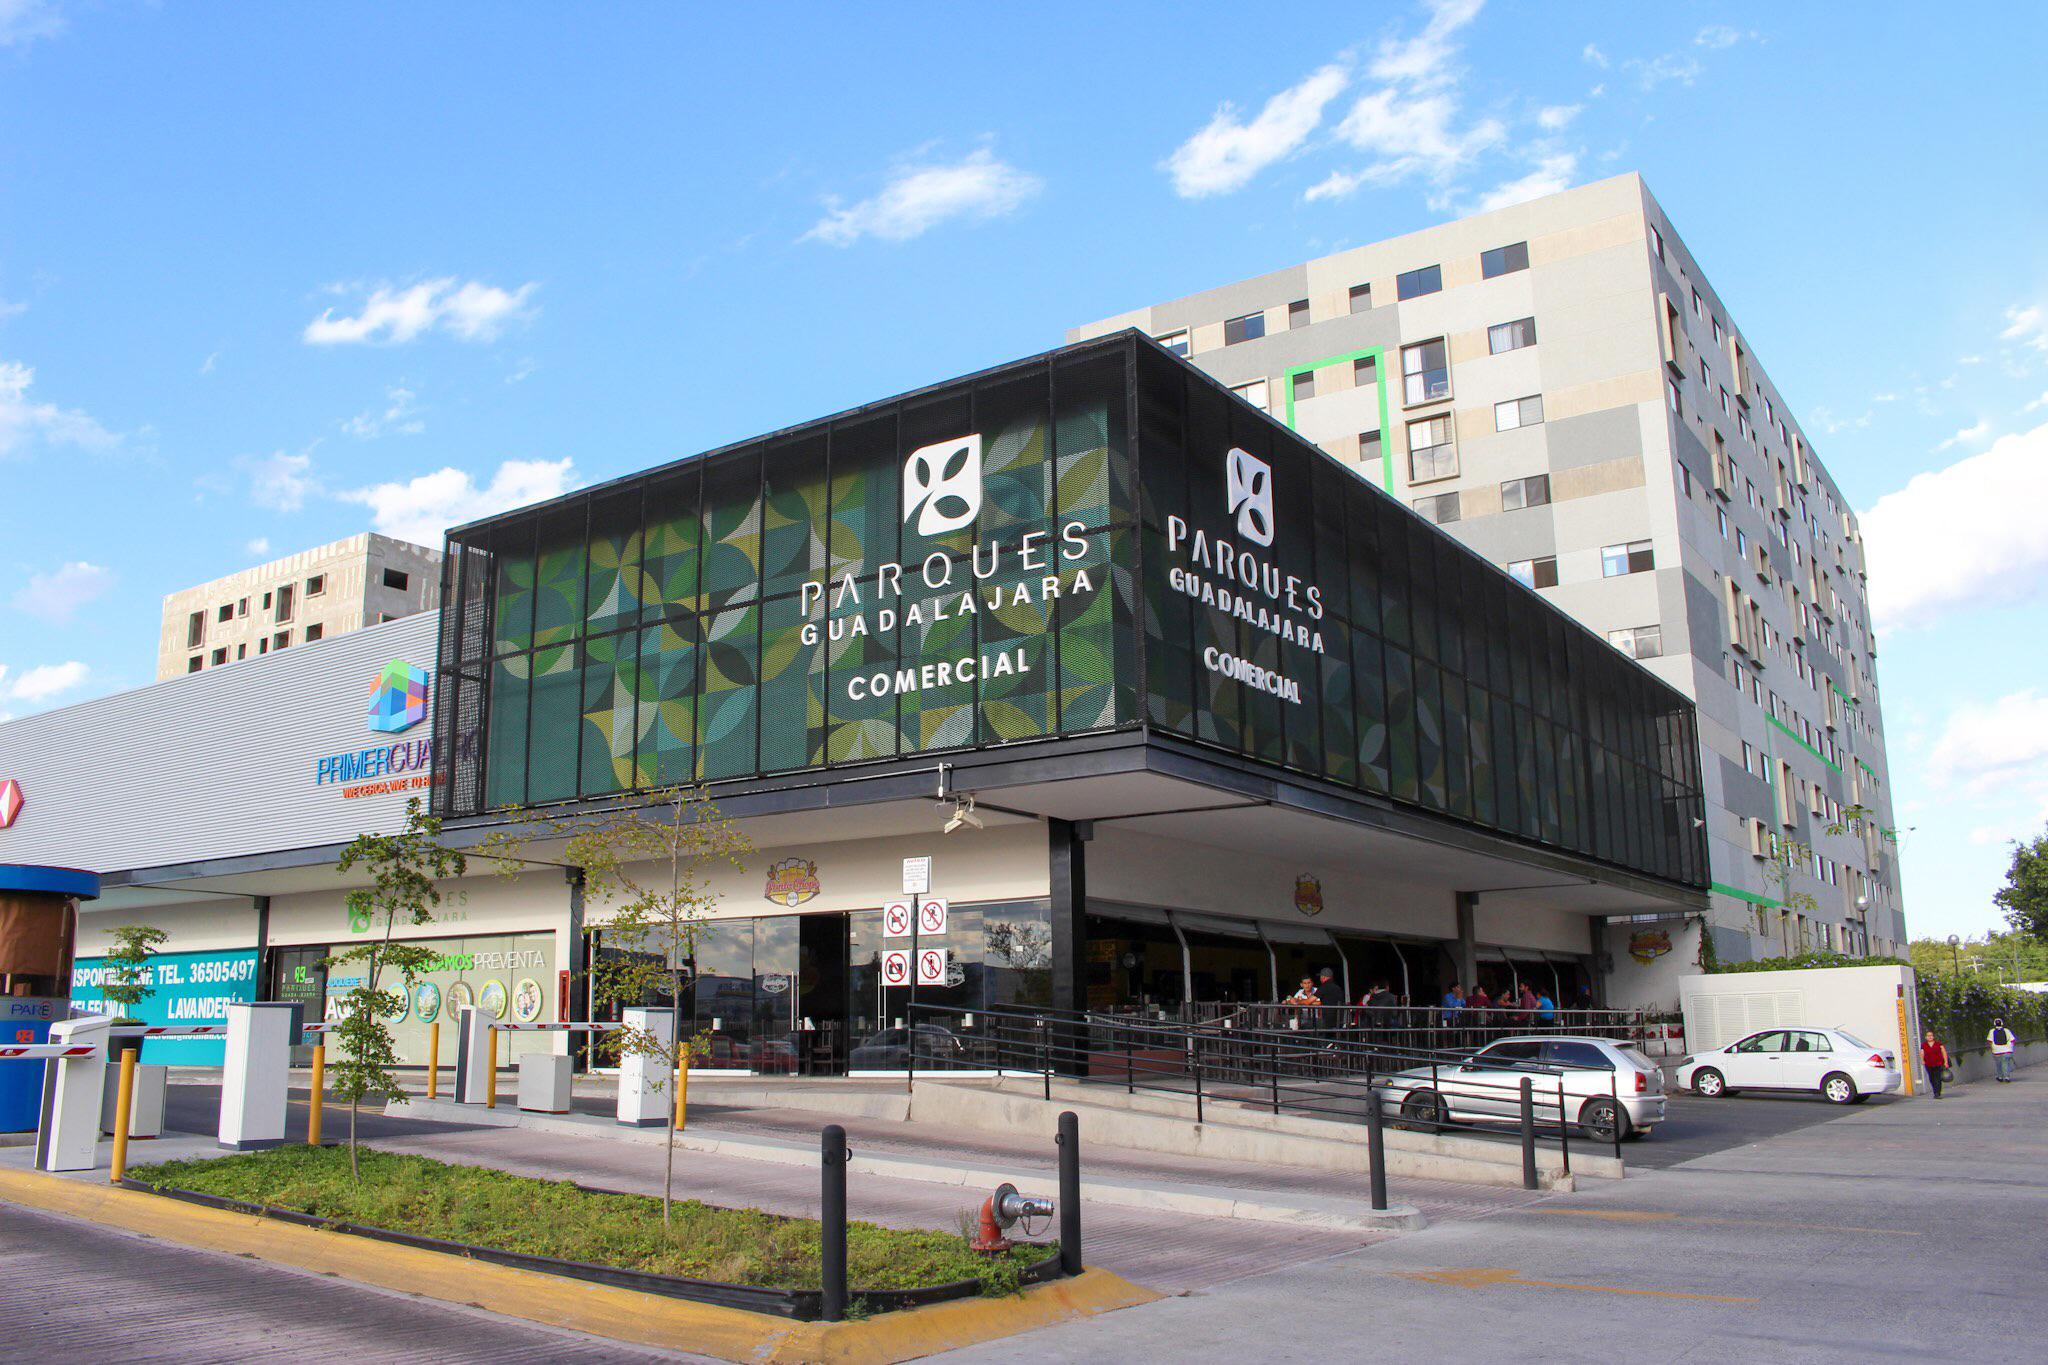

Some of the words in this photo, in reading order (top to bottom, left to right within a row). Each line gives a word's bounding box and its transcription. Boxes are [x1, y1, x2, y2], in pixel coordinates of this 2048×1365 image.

[802, 521, 1089, 616] PARQUES
[1167, 515, 1324, 620] PARQUES
[801, 569, 1094, 646] GUADALAJARA
[1169, 567, 1325, 654] GUADALAJARA
[848, 648, 1031, 701] COMERCIAL
[1203, 646, 1301, 704] COMERCIAL
[316, 739, 433, 785] PRIMERCUA
[72, 967, 130, 988] ISPONIBLE
[158, 964, 184, 985] TEL.
[190, 959, 256, 983] 36505497
[474, 950, 545, 970] PREVENTA
